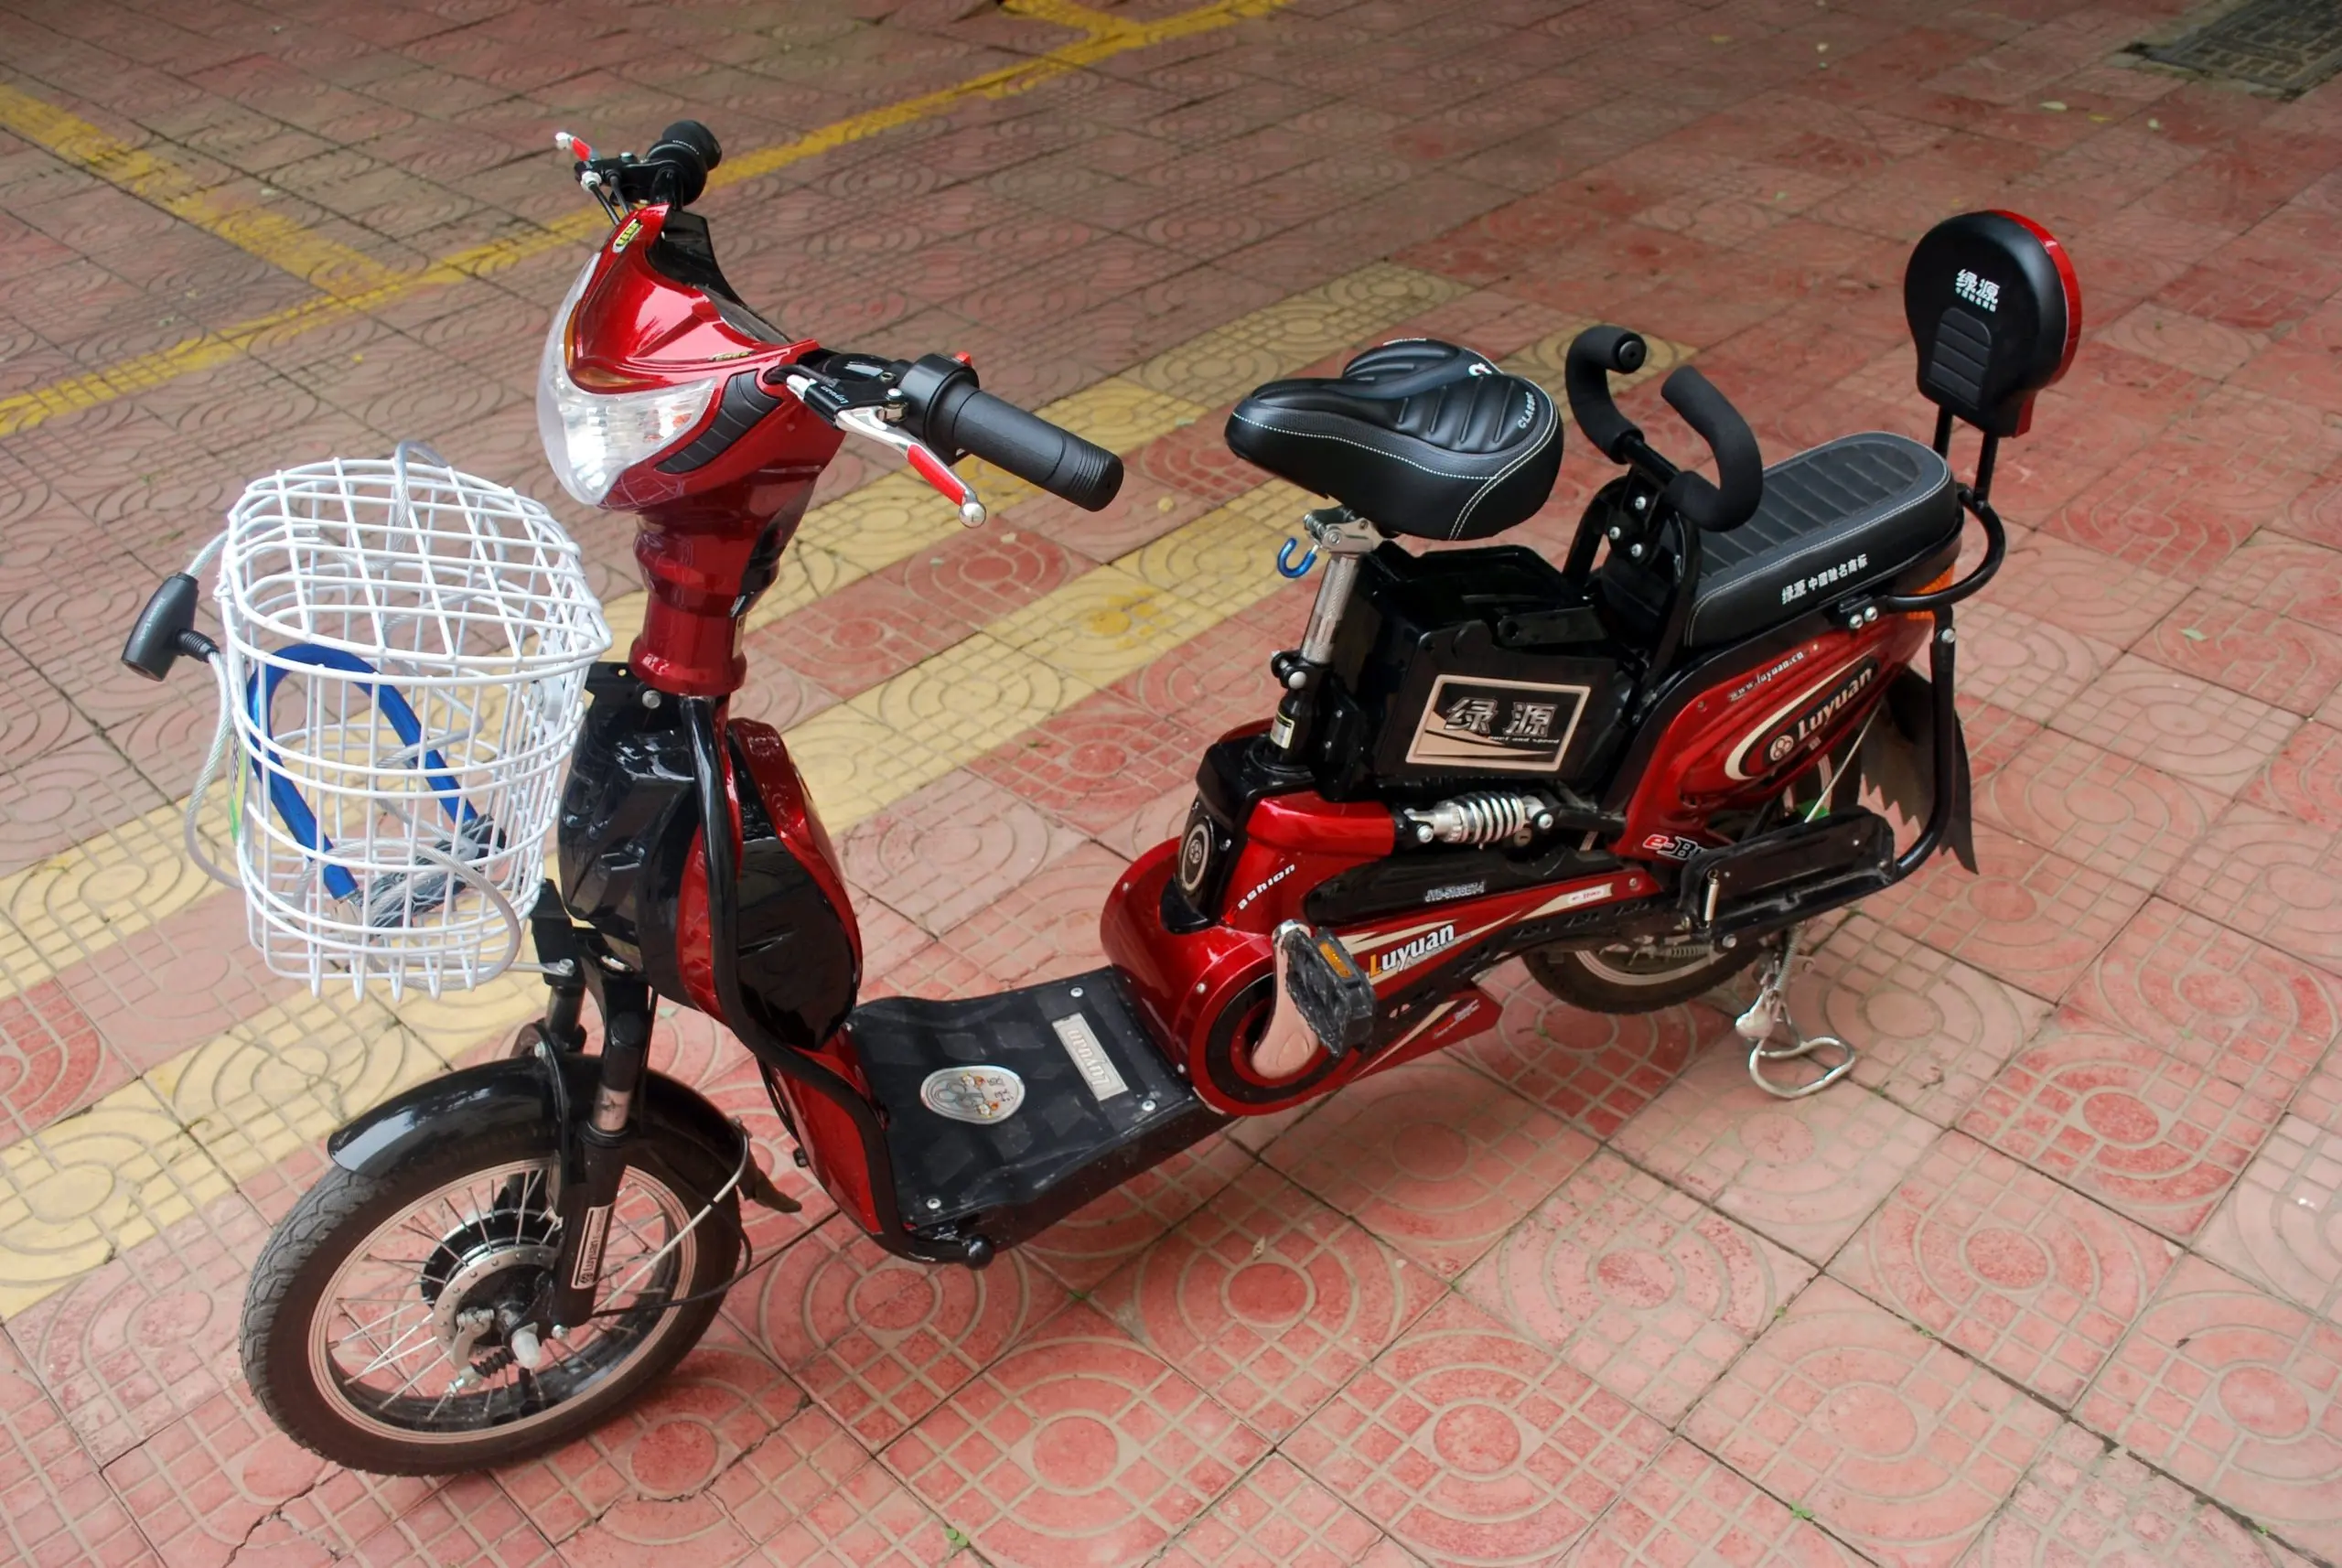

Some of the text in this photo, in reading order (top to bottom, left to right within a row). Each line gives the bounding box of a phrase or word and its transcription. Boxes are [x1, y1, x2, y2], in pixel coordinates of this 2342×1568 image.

[1955, 269, 2000, 305] 绿源
[1444, 697, 1557, 737] 绿源
[1798, 668, 1873, 741] Luyuan
[1369, 923, 1456, 978] Luyuan
[1066, 1029, 1111, 1086] Luyuan
